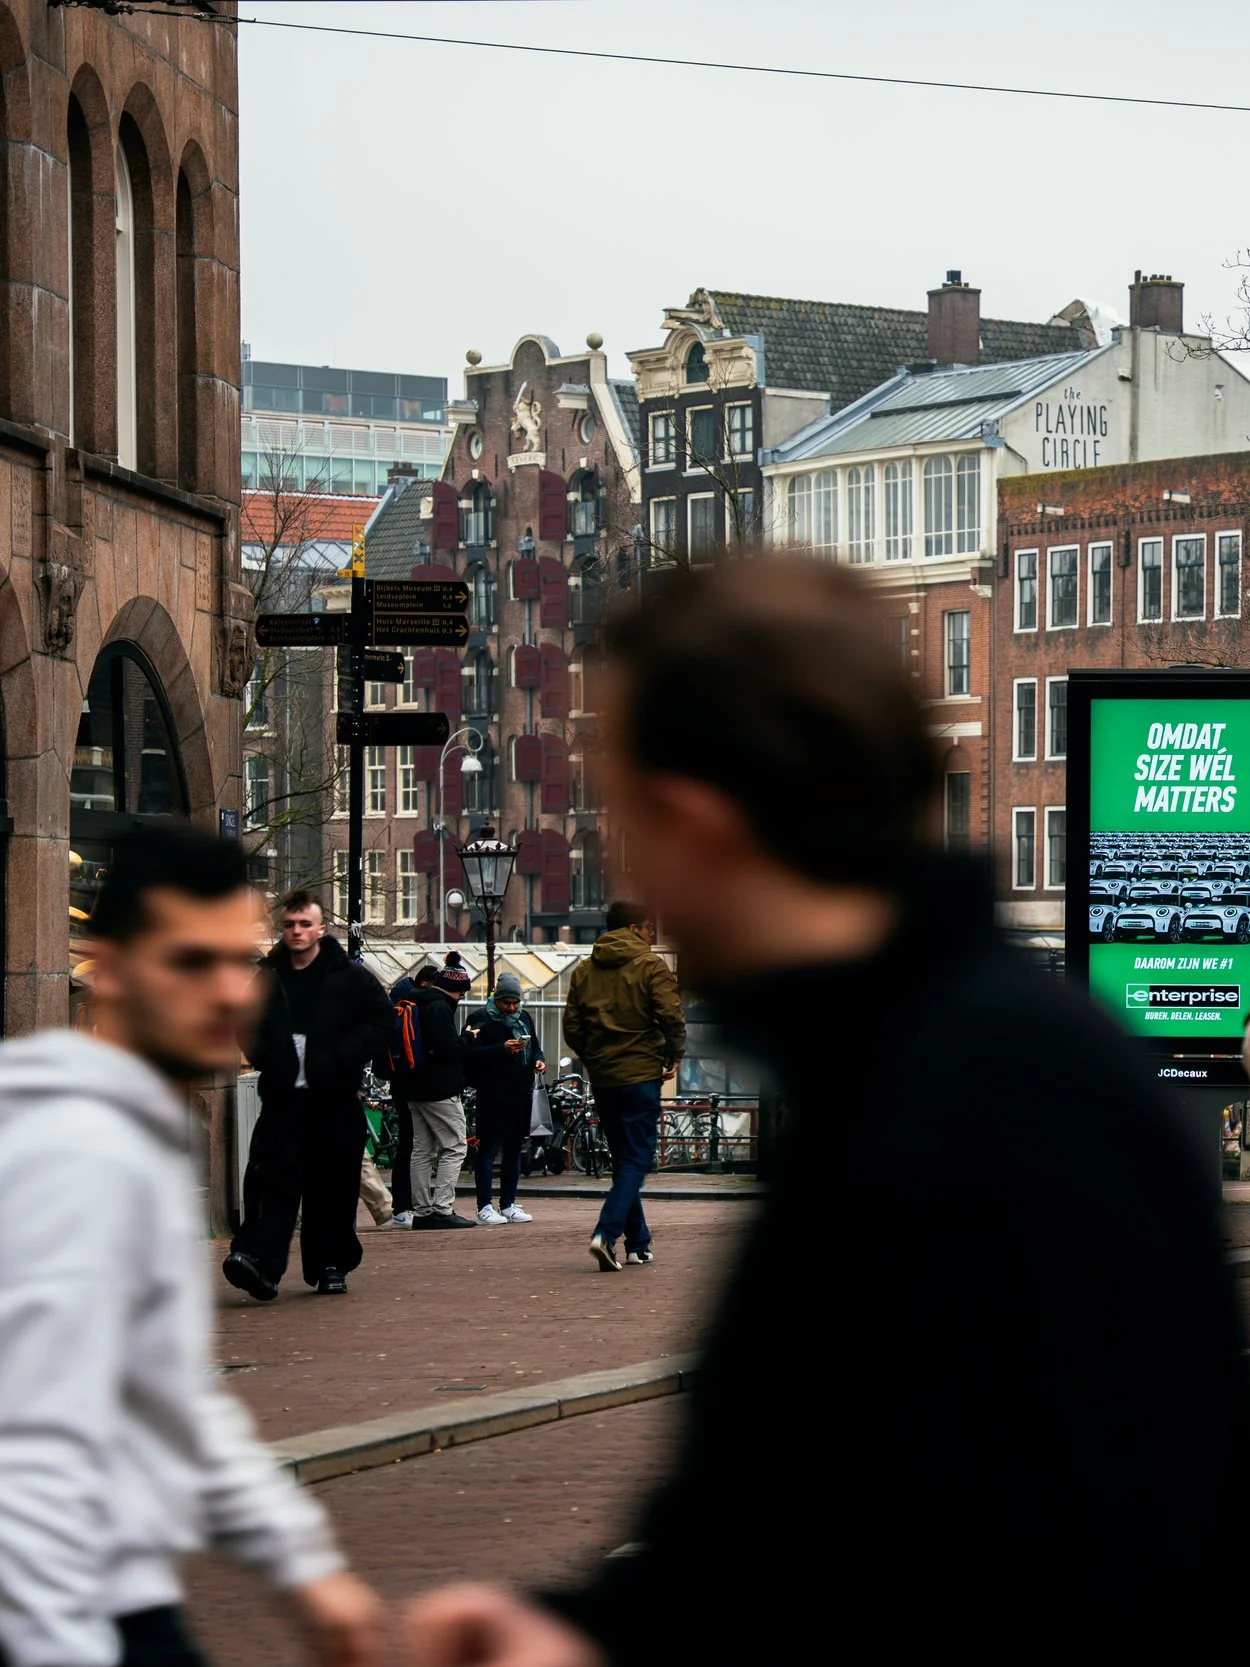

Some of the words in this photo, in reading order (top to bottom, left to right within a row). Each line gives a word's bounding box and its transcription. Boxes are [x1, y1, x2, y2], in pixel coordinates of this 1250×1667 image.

[1064, 387, 1081, 400] the
[1036, 402, 1108, 437] PLAYING
[1042, 437, 1100, 469] CIRCLE
[376, 585, 401, 593] Bijbels
[376, 593, 417, 601] Leidseplein
[391, 626, 440, 634] Grachtenhuis
[1146, 722, 1227, 750] OMDAT
[1134, 753, 1185, 781] SIZE
[1189, 746, 1237, 781] WÉL
[1133, 785, 1238, 813] MATTERS
[1133, 957, 1176, 970] DAAROM
[1177, 957, 1201, 970] ZIJN
[1202, 957, 1219, 970] WE
[1219, 957, 1234, 970] #1
[1132, 988, 1239, 1006] enterprise
[1144, 1011, 1170, 1021] HUREN.
[1170, 1011, 1194, 1021] DELEN.
[1194, 1012, 1222, 1021] LEASEN.
[1157, 1068, 1208, 1078] JCDecaux
